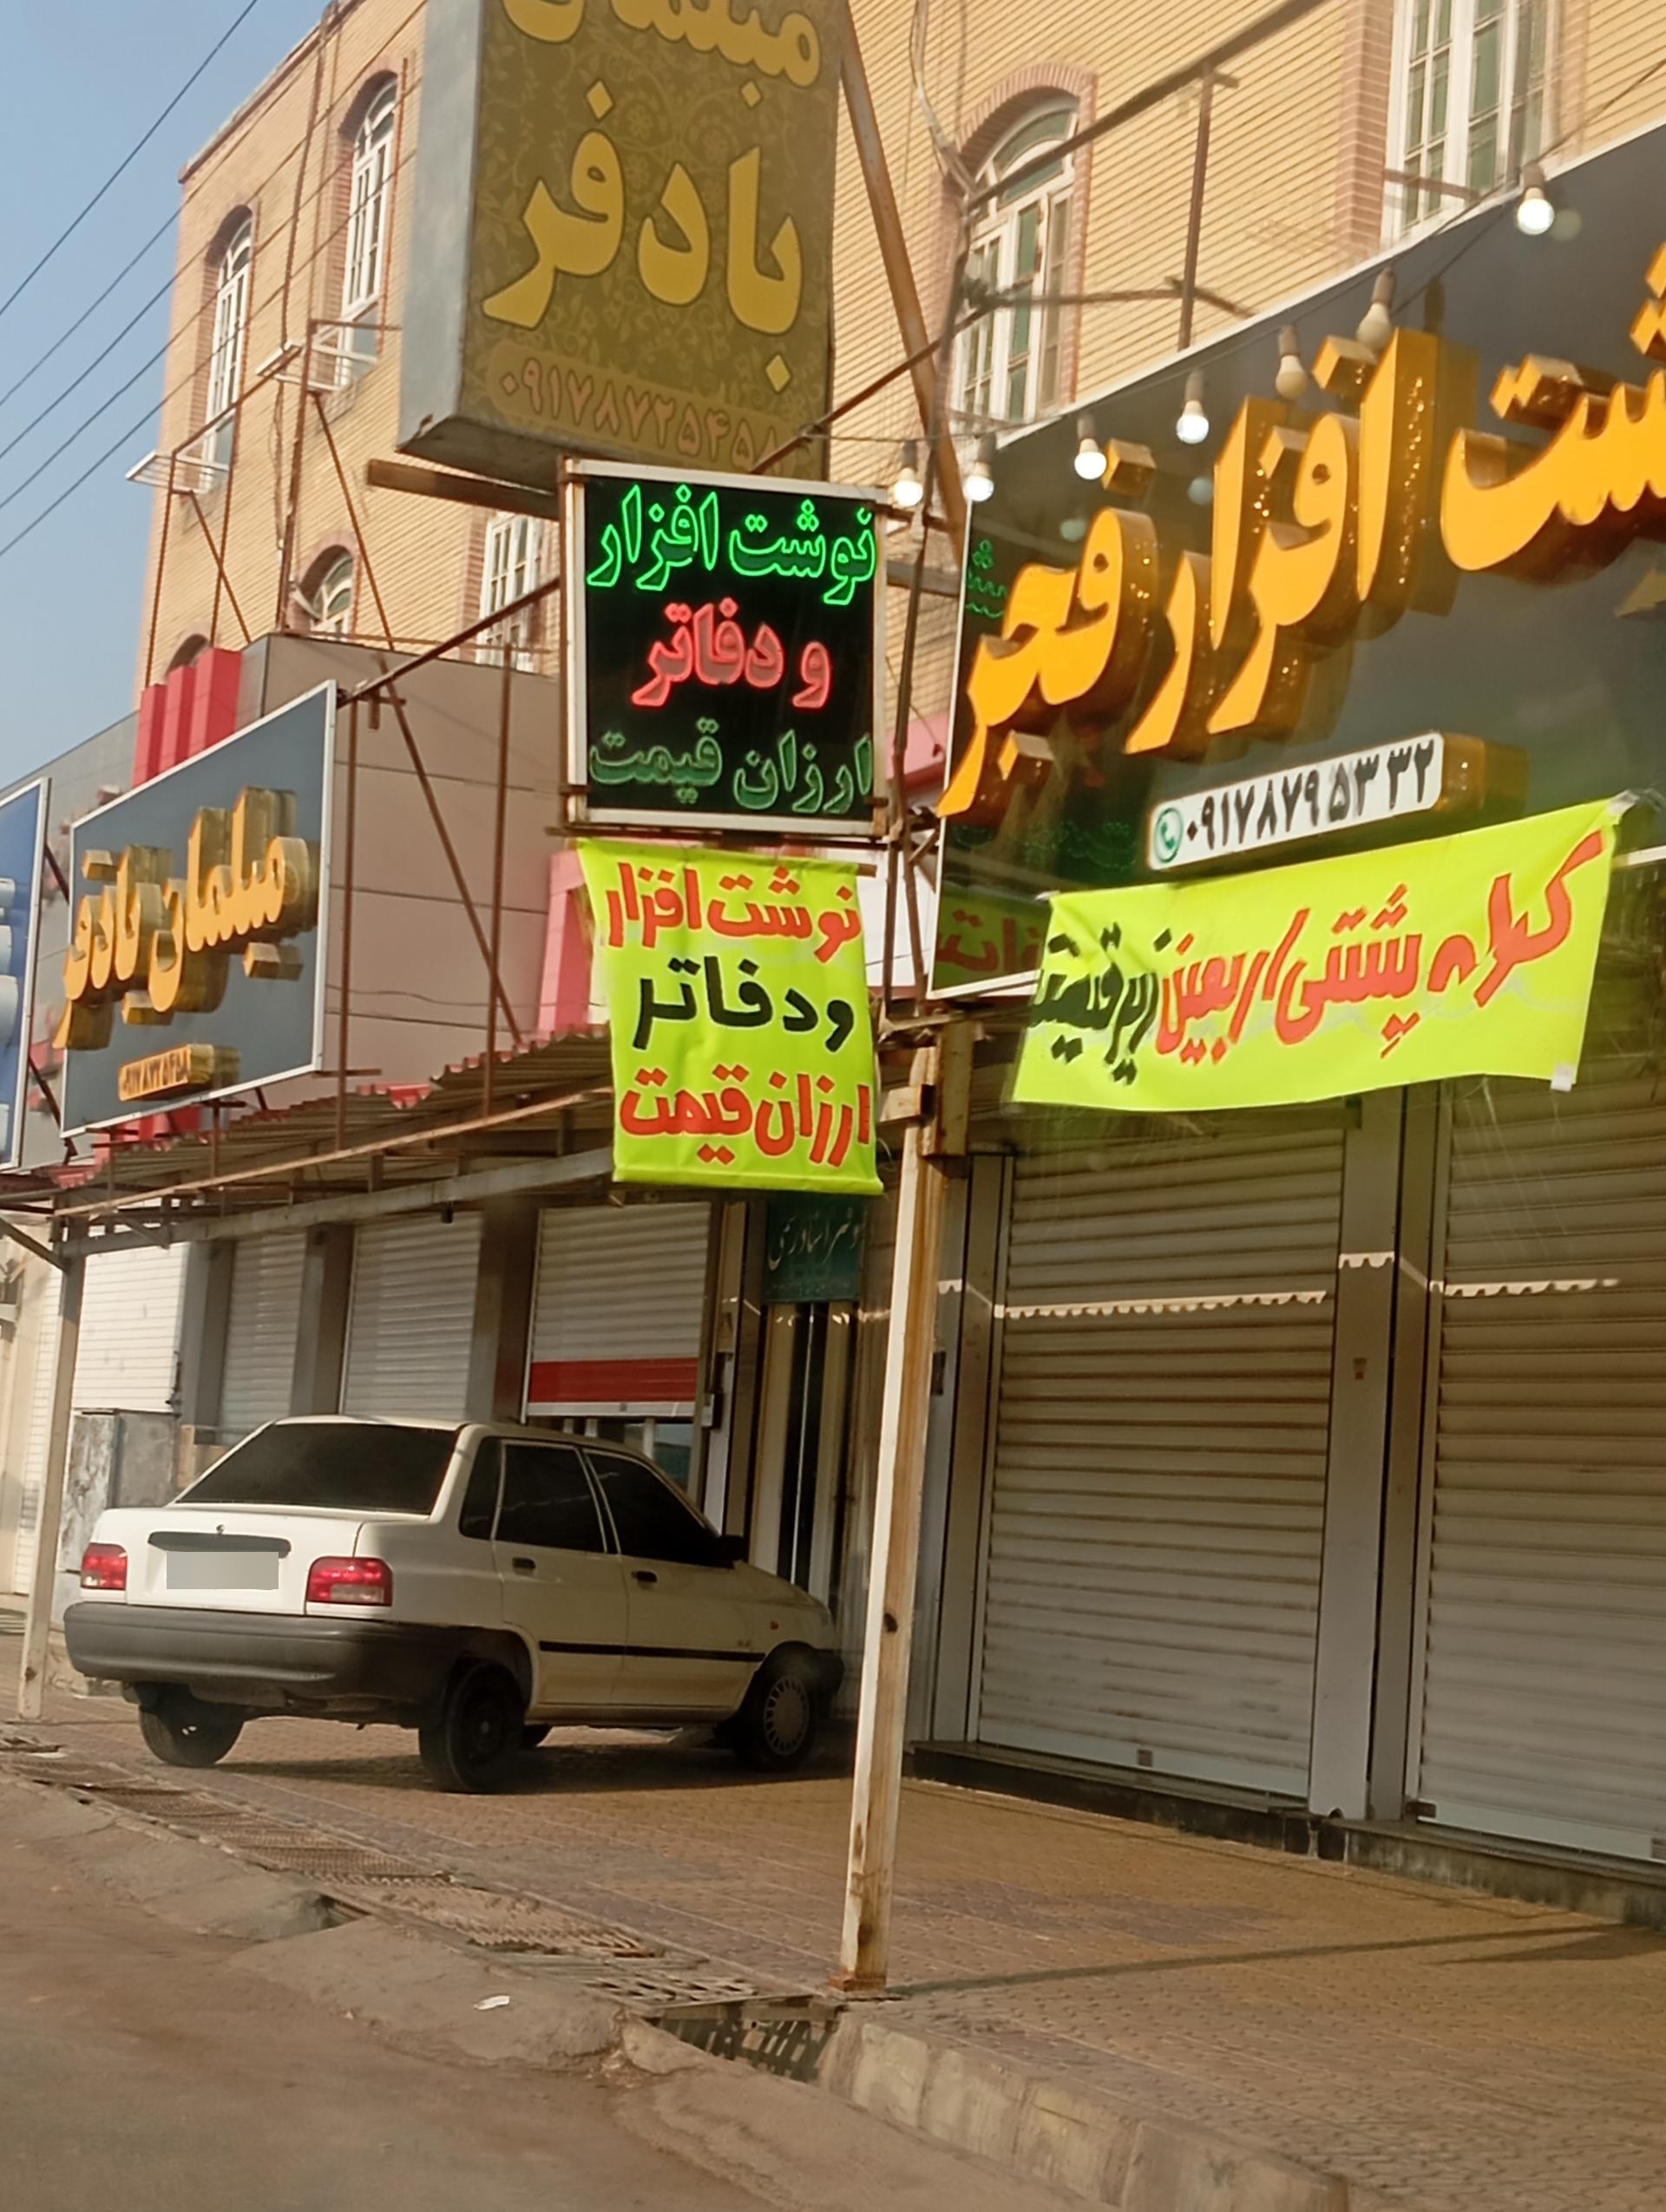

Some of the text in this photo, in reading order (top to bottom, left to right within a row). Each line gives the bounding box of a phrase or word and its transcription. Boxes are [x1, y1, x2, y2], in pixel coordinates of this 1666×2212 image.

[587, 483, 719, 592] افزار
[729, 499, 876, 605] نوشت
[1125, 328, 1397, 755] افزار
[632, 597, 830, 708] و دفاتر
[935, 438, 1125, 818] فجر
[588, 717, 875, 814] ارزان قیمت
[1186, 738, 1434, 850] ۰۹۱۷۸۷۹۵۳۳۲
[606, 862, 702, 948] افزار
[706, 865, 862, 963] نوشت
[1276, 883, 1423, 1058] پشتی
[619, 1063, 870, 1168] ارزان قیمت
